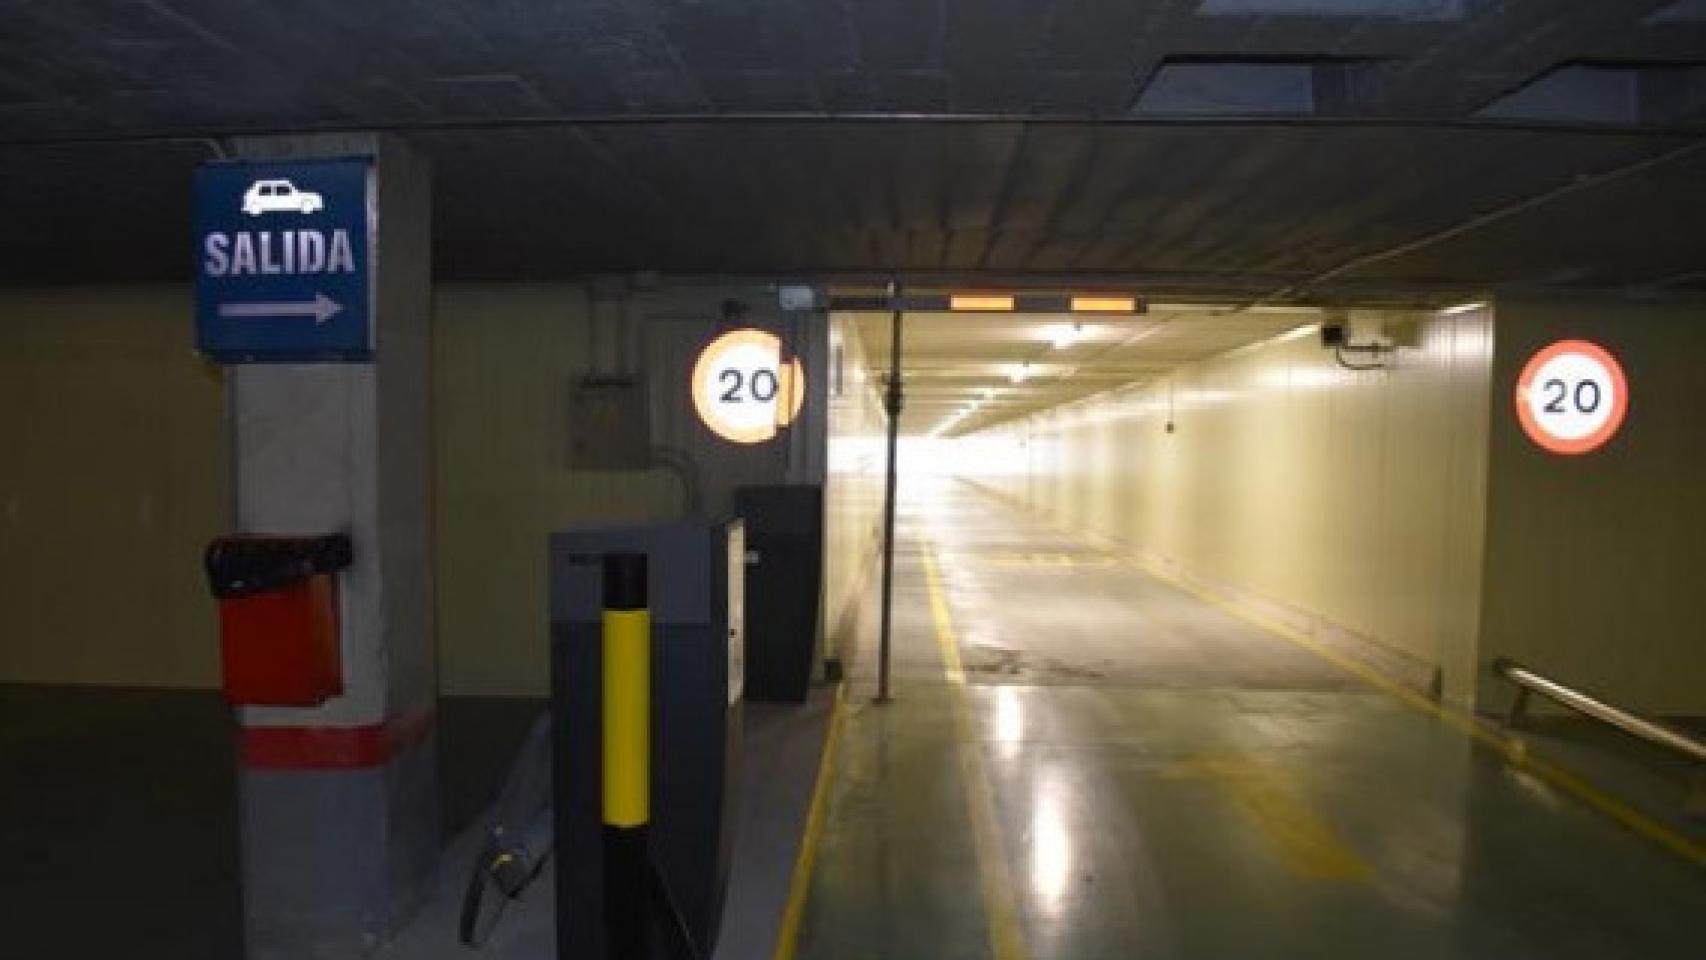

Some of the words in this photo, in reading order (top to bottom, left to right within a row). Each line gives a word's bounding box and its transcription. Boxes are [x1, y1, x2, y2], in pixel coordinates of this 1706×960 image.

[204, 229, 355, 276] SALIDA
[719, 367, 779, 403] 20
[1543, 378, 1600, 414] 20
